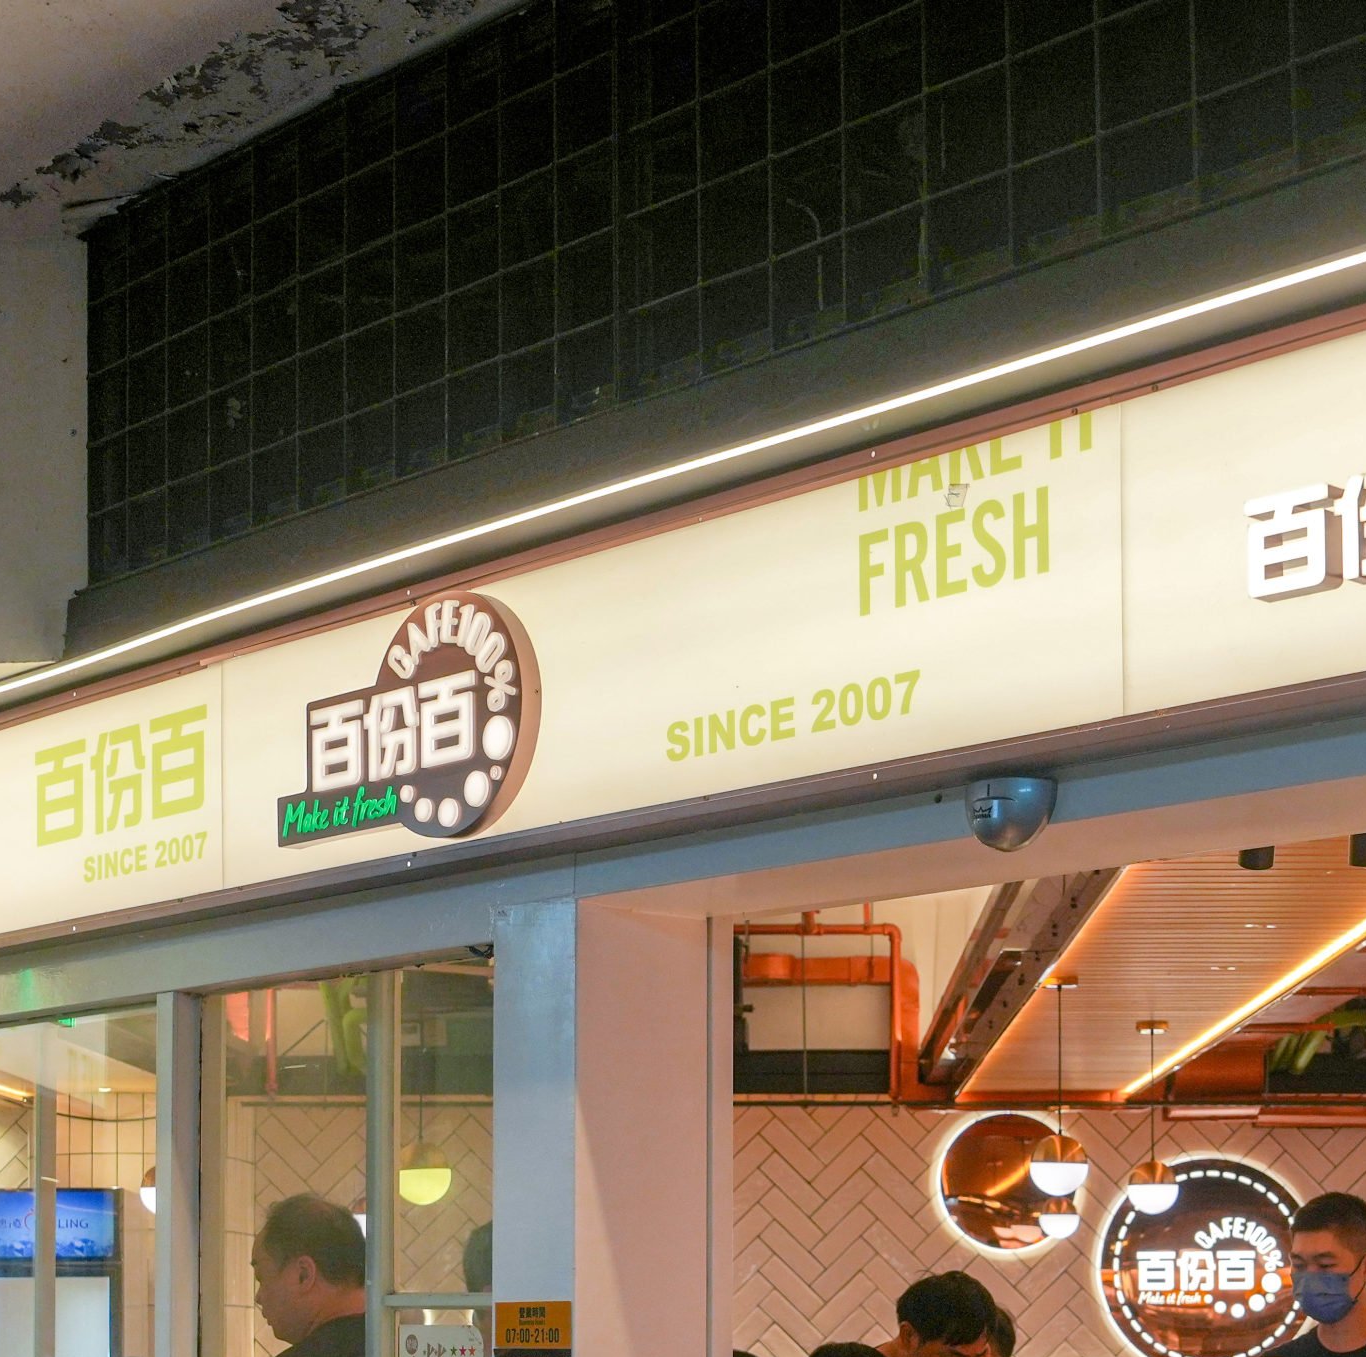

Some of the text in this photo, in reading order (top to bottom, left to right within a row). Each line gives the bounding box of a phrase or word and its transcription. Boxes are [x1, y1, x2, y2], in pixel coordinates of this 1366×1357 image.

[858, 486, 1050, 616] FRESH
[310, 669, 478, 793] 百份百
[665, 669, 922, 763] SINCE 2007
[35, 704, 207, 847] 百份百
[282, 785, 397, 838] Make it fresh
[83, 831, 207, 883] SINCE 2007
[1136, 1250, 1256, 1291] 百份百
[1138, 1291, 1164, 1305] Make
[1176, 1291, 1202, 1305] fresh
[505, 1328, 560, 1344] 07:00-21:00
